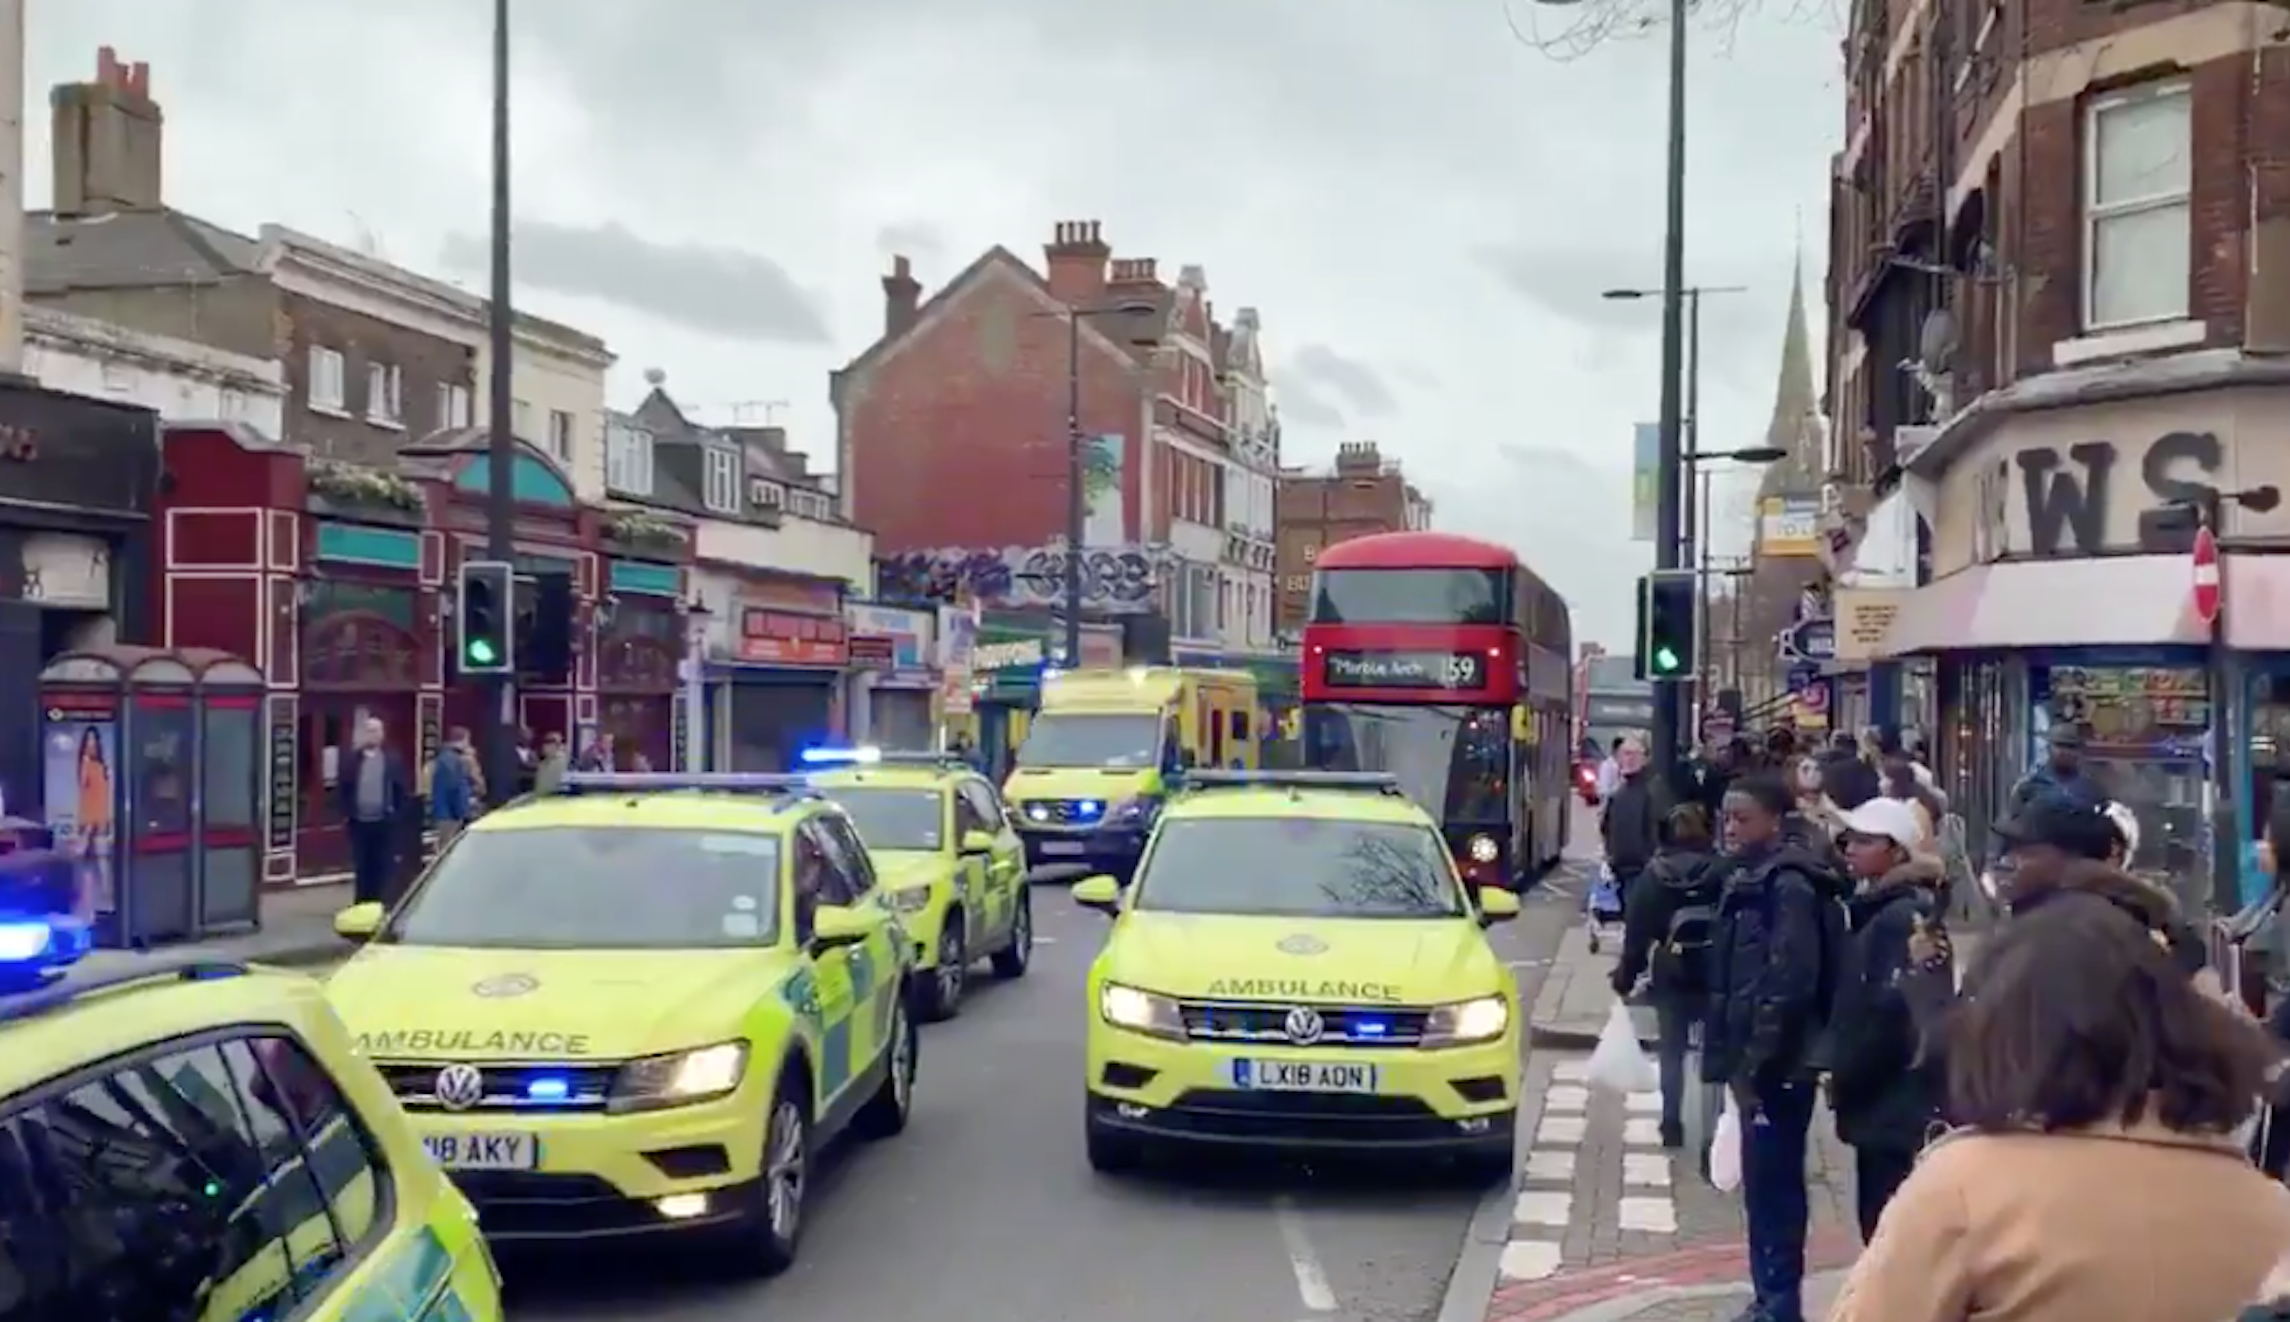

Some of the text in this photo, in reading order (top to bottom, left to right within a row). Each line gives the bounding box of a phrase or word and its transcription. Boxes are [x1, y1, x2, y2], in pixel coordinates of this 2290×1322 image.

[1208, 978, 1402, 1003] AMBULANCE
[356, 1029, 590, 1054] AMBULANCE
[1259, 1062, 1310, 1086] LX18
[422, 1135, 521, 1163] 18 AKY
